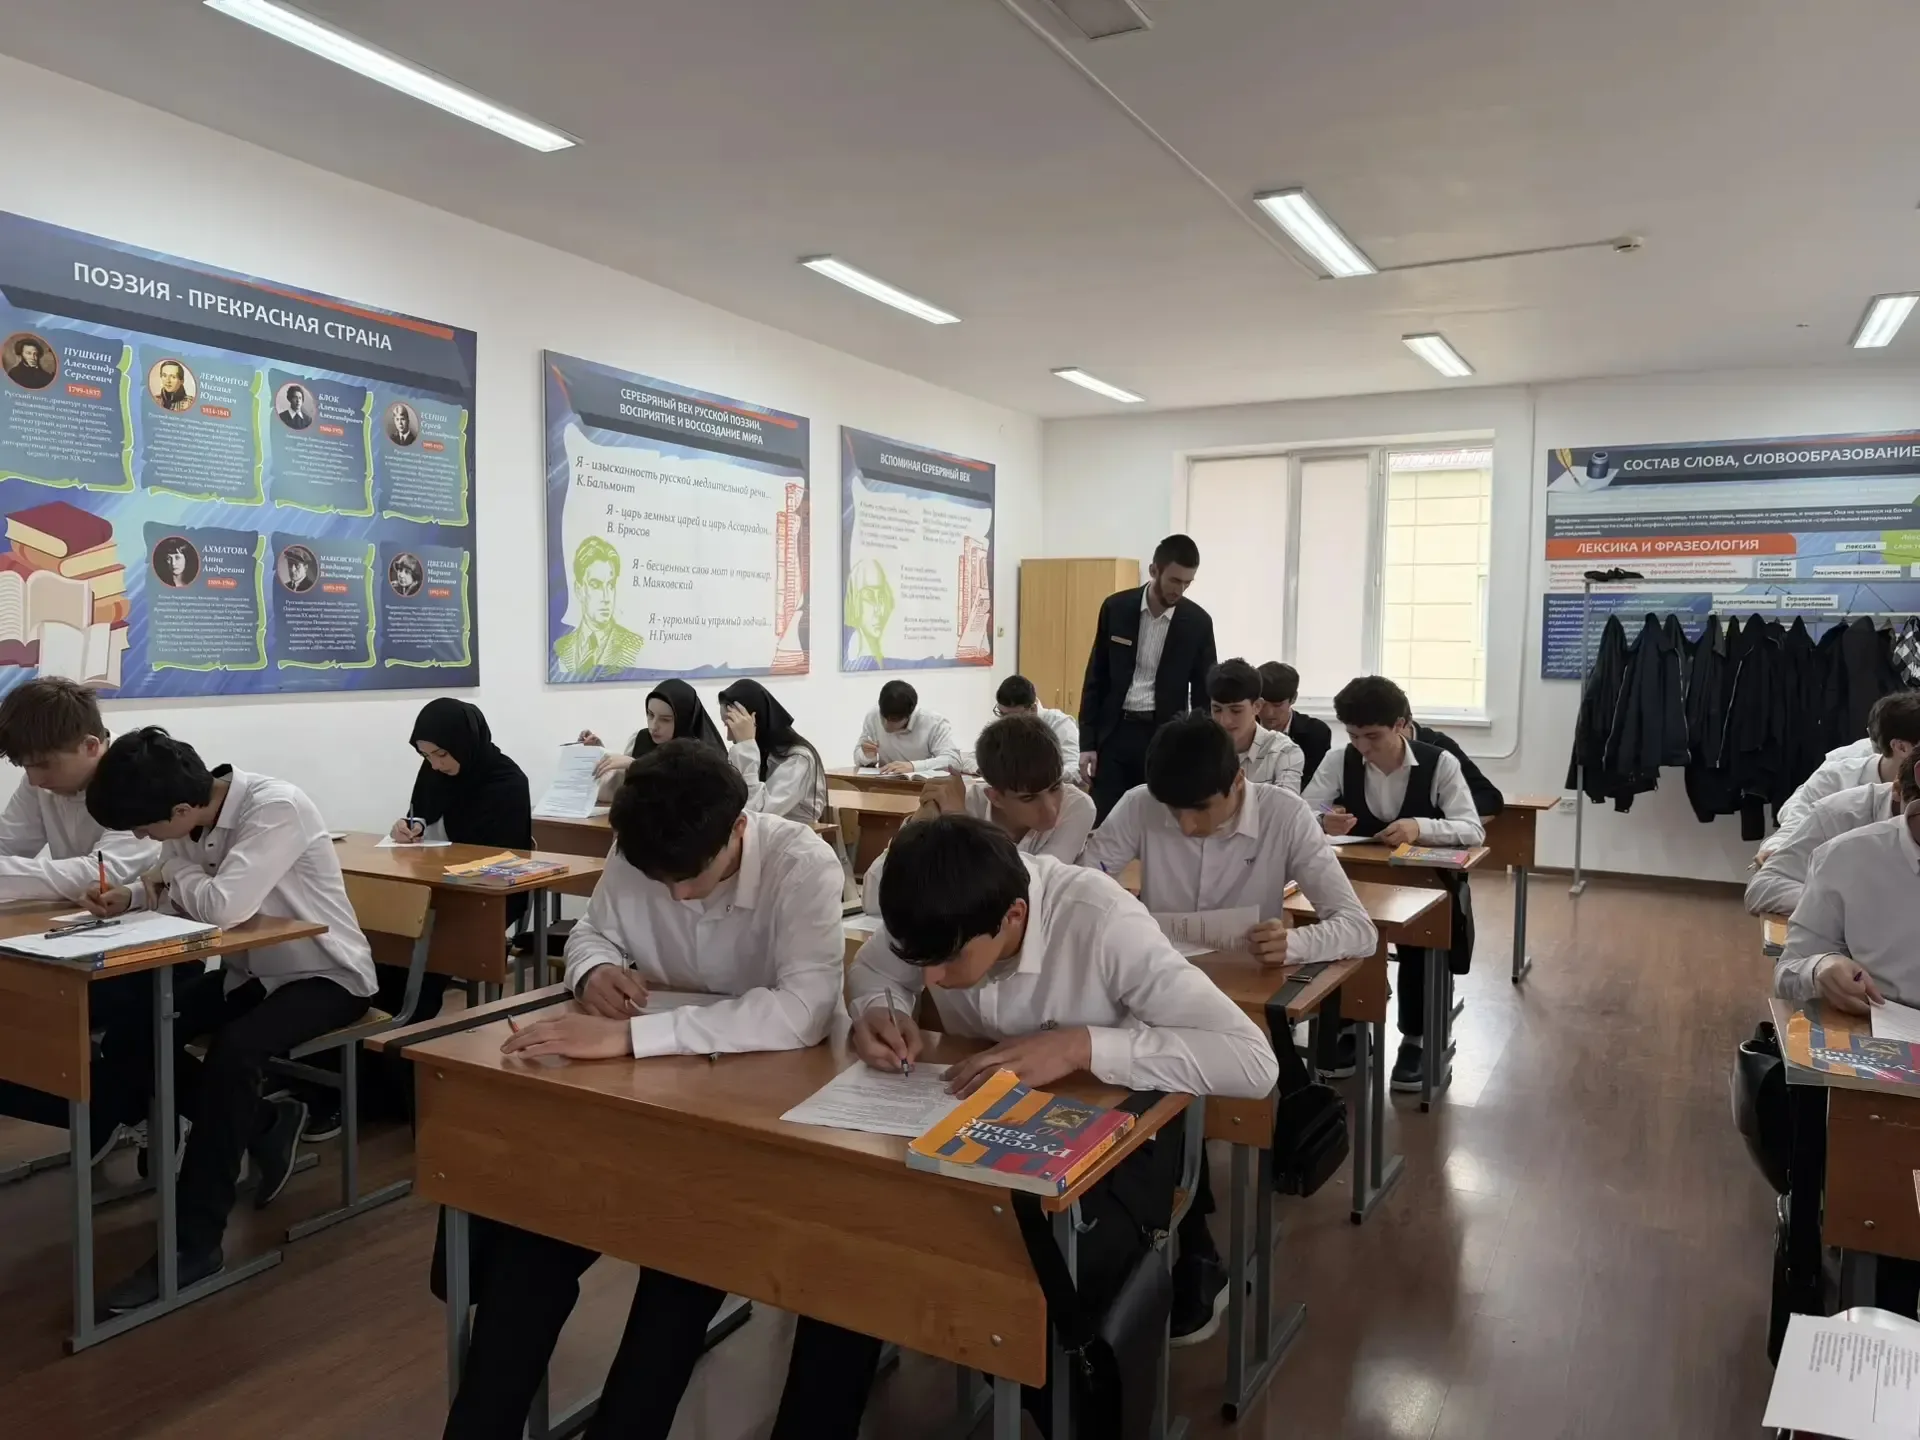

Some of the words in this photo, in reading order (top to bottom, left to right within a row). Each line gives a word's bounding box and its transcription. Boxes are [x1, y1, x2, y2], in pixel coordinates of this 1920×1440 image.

[74, 262, 170, 301] ПОЭЗИЯ
[189, 289, 319, 334] ПРЕКРАСНАЯ
[324, 321, 392, 351] СТРАНА
[64, 347, 112, 363] ПУШКИН
[63, 358, 115, 374] Александр
[64, 369, 113, 384] Сергеевич
[200, 372, 248, 387] ЛЕРМОНТОВ
[68, 386, 101, 396] 1799-1837
[200, 382, 231, 394] Михаил
[200, 392, 237, 404] Юрьевич
[319, 393, 339, 403] БЛОК
[319, 403, 355, 416] Александр
[620, 388, 676, 410] СЕРЕБРЯНЫЙ
[678, 402, 693, 415] ВЕК
[695, 406, 729, 423] РУССКОЙ
[730, 414, 762, 431] ПОЭЗИИ.
[620, 404, 676, 425] ВОСПРИЯТИЕ
[677, 417, 684, 427] И
[685, 418, 740, 440] ВОССОЗДАНИЕ
[742, 432, 763, 445] МИРА
[1623, 458, 1680, 470] СОСТАВ
[1684, 455, 1739, 468] СЛОВА,
[1743, 445, 1920, 466] СЛОВООБРАЗОВАНИЕ
[880, 453, 920, 472] ВСПОМИНАЯ
[921, 463, 959, 480] СЕРЕБРЯНЫЙ
[960, 471, 970, 482] ВЕК
[575, 456, 584, 468] Я
[591, 461, 658, 481] изысканность
[659, 473, 692, 486] русской
[692, 479, 748, 495] медлительной
[606, 504, 613, 515] Я
[621, 508, 642, 520] царь
[643, 511, 675, 523] земных
[677, 515, 700, 528] царей
[708, 520, 726, 531] царь
[607, 521, 615, 533] В.
[617, 523, 650, 538] Брюсов
[202, 545, 248, 556] АХМАТОВА
[1576, 541, 1638, 553] ЛЕКСИКА
[1642, 542, 1651, 552] И
[1655, 539, 1760, 551] ФРАЗЕОЛОГИЯ
[202, 556, 224, 564] Анна
[427, 560, 458, 569] ЦВЕТАЕВА
[632, 559, 639, 570] Я
[646, 559, 691, 576] бесценных
[692, 566, 709, 575] слов
[203, 565, 245, 575] Андреевна
[632, 576, 641, 588] В.
[643, 576, 694, 591] Маяковский
[649, 612, 656, 625] Я
[662, 615, 700, 628] угрюмый
[707, 616, 741, 628] упрямый
[955, 1126, 1076, 1158] Русский
